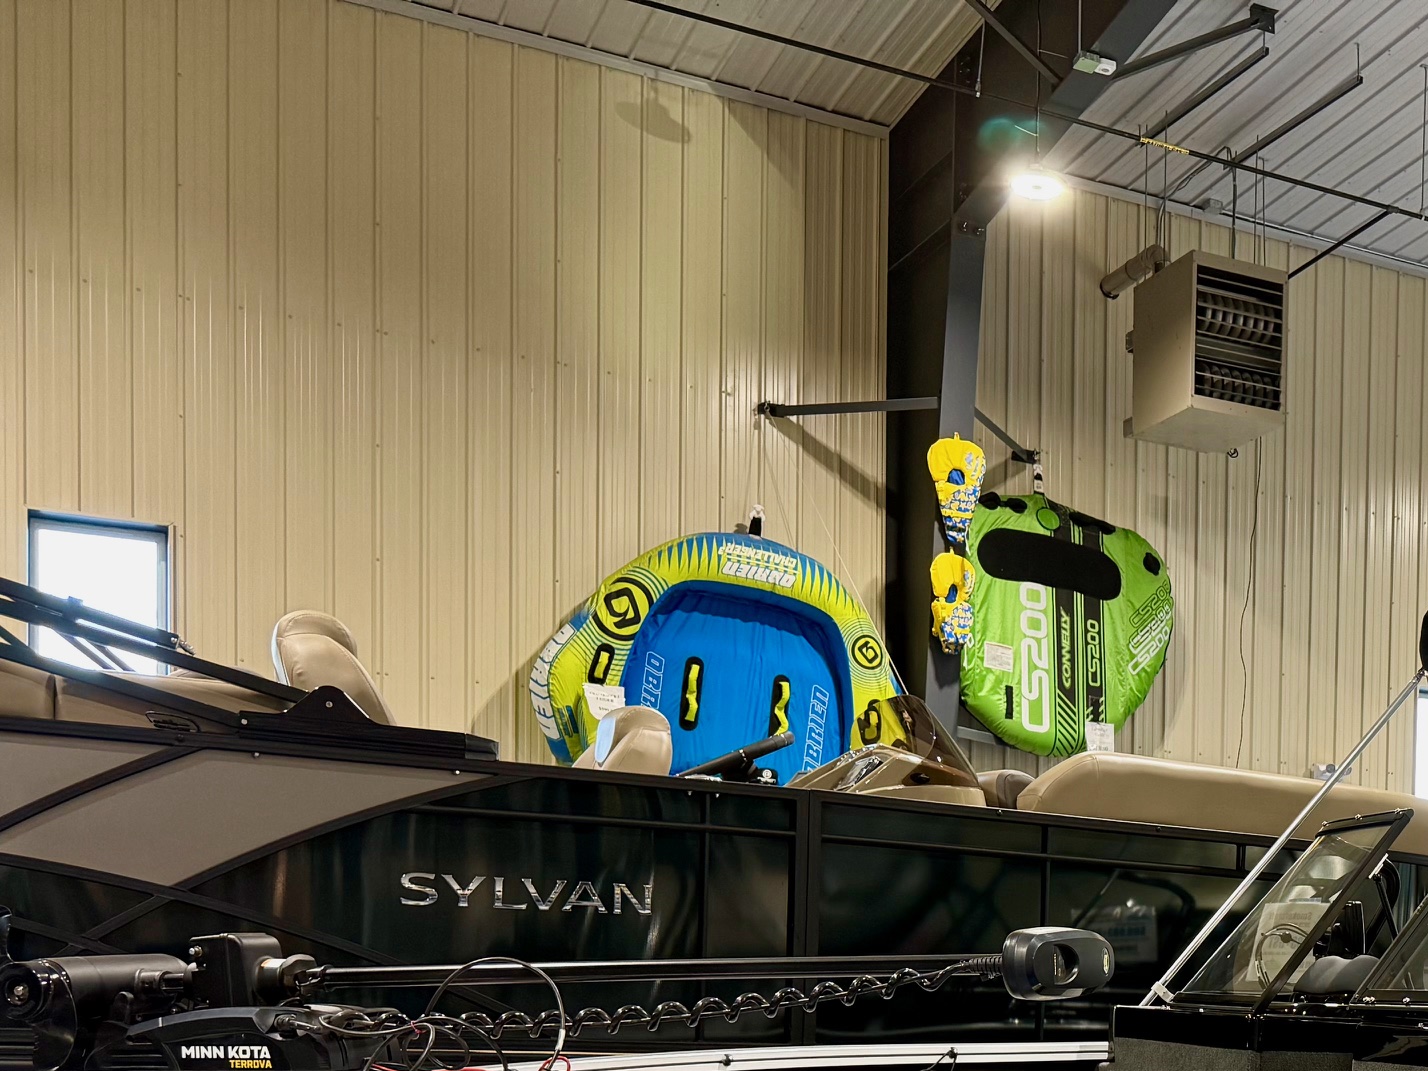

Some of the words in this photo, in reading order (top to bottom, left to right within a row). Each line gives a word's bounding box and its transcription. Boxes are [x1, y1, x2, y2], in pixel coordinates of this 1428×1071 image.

[1019, 581, 1051, 734] CS200
[1059, 605, 1072, 691] CONNELLY
[1085, 619, 1102, 687] CS200
[400, 871, 653, 916] SYLVAN
[181, 1045, 225, 1059] MINN
[227, 1045, 271, 1059] KOTA
[229, 1059, 273, 1069] TERROVA
